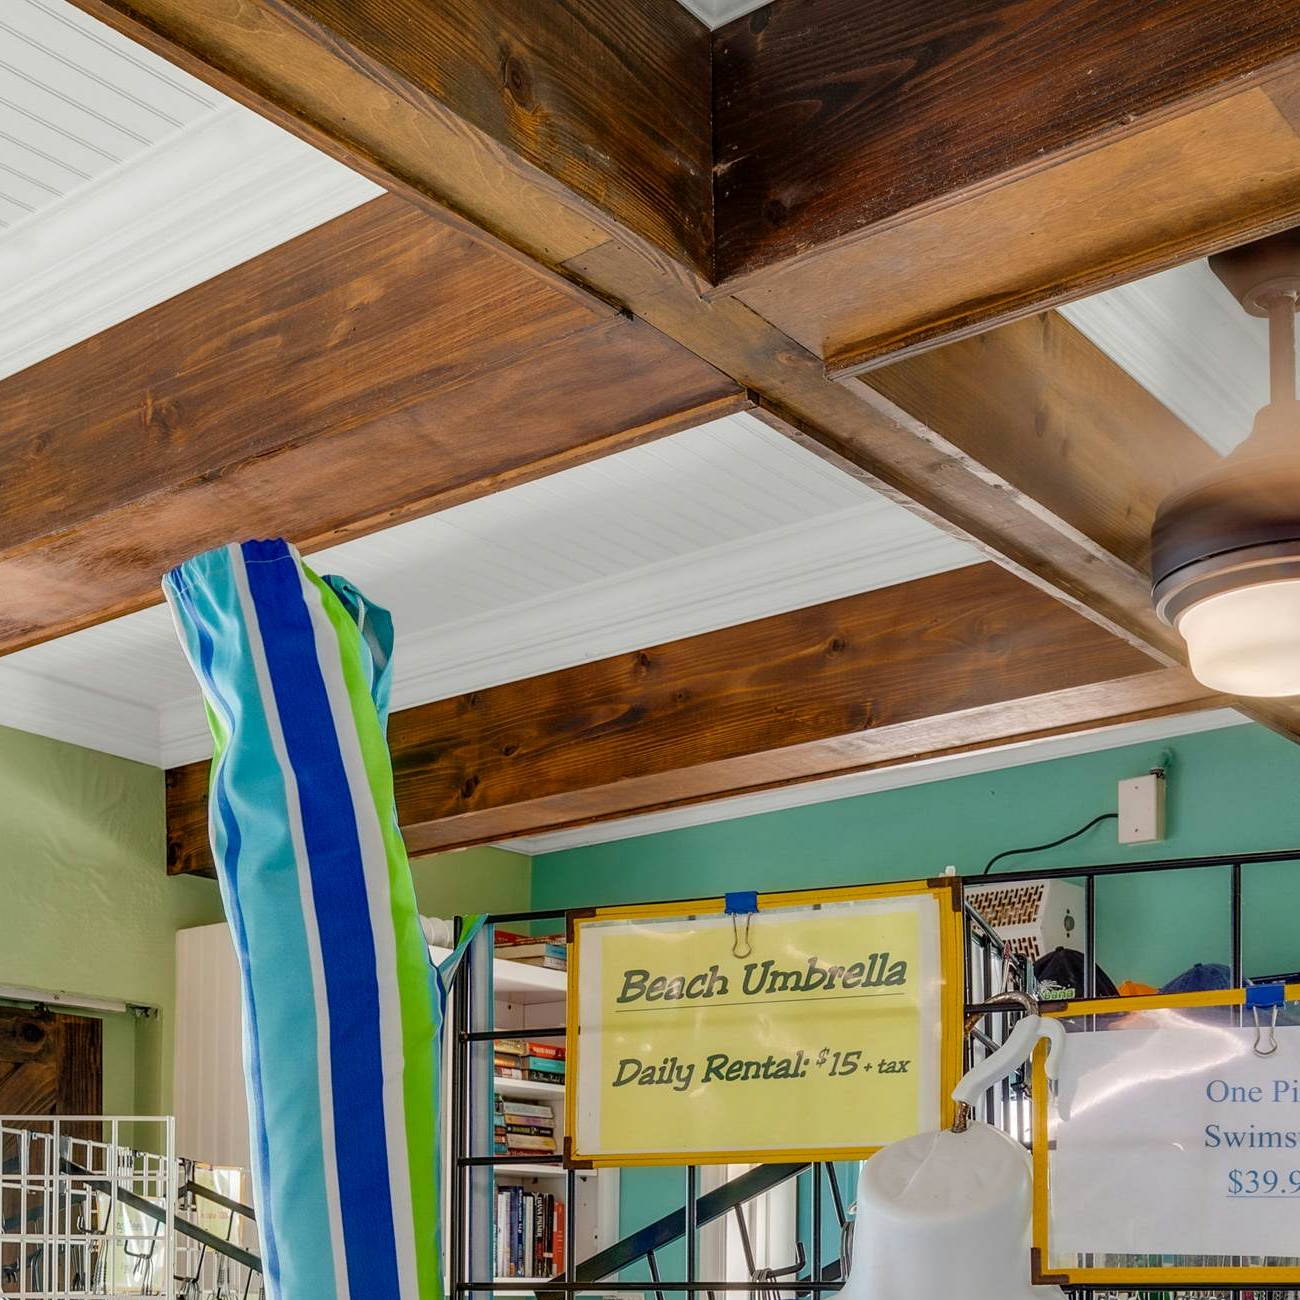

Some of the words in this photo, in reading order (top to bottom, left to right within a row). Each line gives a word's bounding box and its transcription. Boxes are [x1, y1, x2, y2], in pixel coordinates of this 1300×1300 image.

[616, 965, 729, 1003] Beach
[741, 952, 908, 996] Umbrella
[612, 1056, 696, 1092] Daily
[700, 1050, 810, 1084] Rental:
[815, 1047, 862, 1077] $15
[878, 1057, 911, 1075] tax
[1205, 1079, 1263, 1104] One
